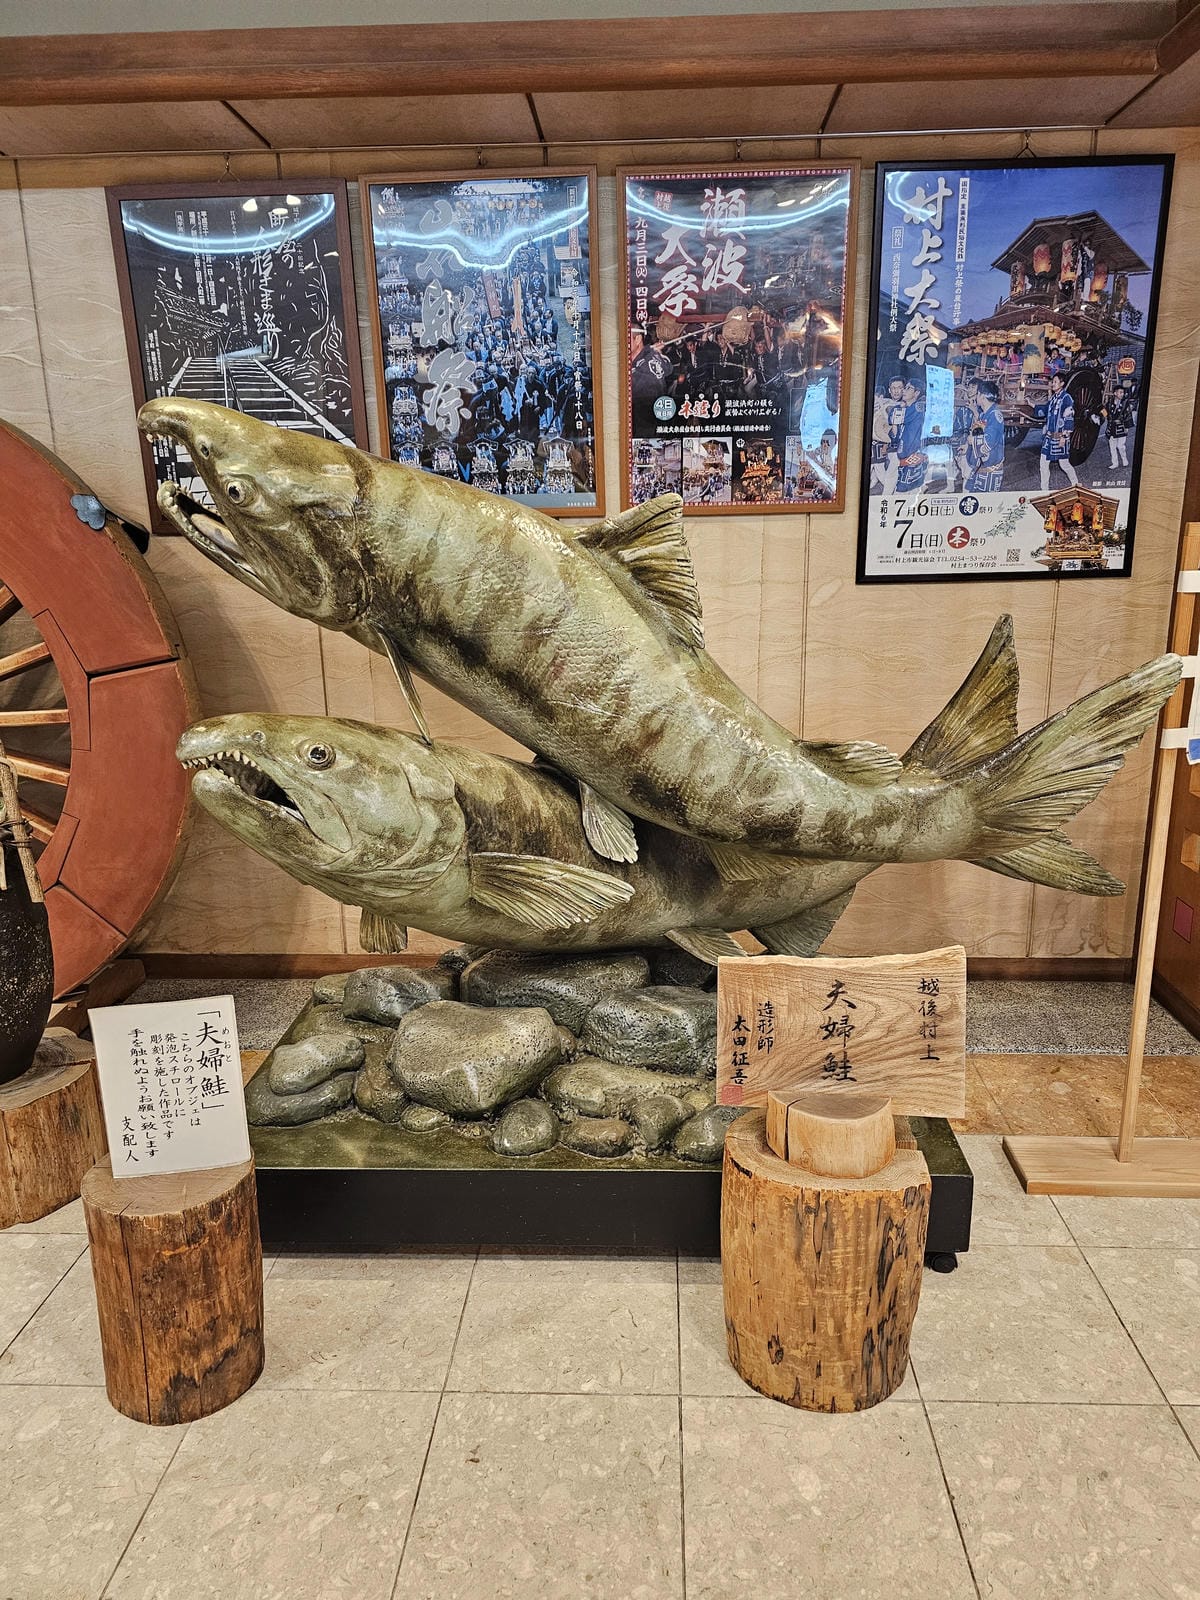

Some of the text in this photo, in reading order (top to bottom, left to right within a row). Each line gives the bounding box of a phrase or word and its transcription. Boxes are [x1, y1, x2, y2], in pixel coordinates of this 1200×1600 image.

[700, 187, 748, 294] 瀬波
[899, 177, 953, 365] 村上大祭
[879, 500, 888, 528] 令和6年
[893, 520, 943, 549] 7日(日)
[195, 1010, 230, 1111] 「夫婦鮭」
[222, 1027, 232, 1063] めおと
[757, 1000, 775, 1054] 造形師
[820, 979, 858, 1083] 夫婦鮭
[917, 977, 943, 1062] 越後村上
[128, 1028, 159, 1158] 手を触れぬようお願い致します
[150, 1034, 174, 1140] 彫刻を施した作品です
[164, 1032, 186, 1118] 発泡スチロールに
[180, 1034, 201, 1127] こちらのオブジェは
[121, 1115, 140, 1163] 支配人
